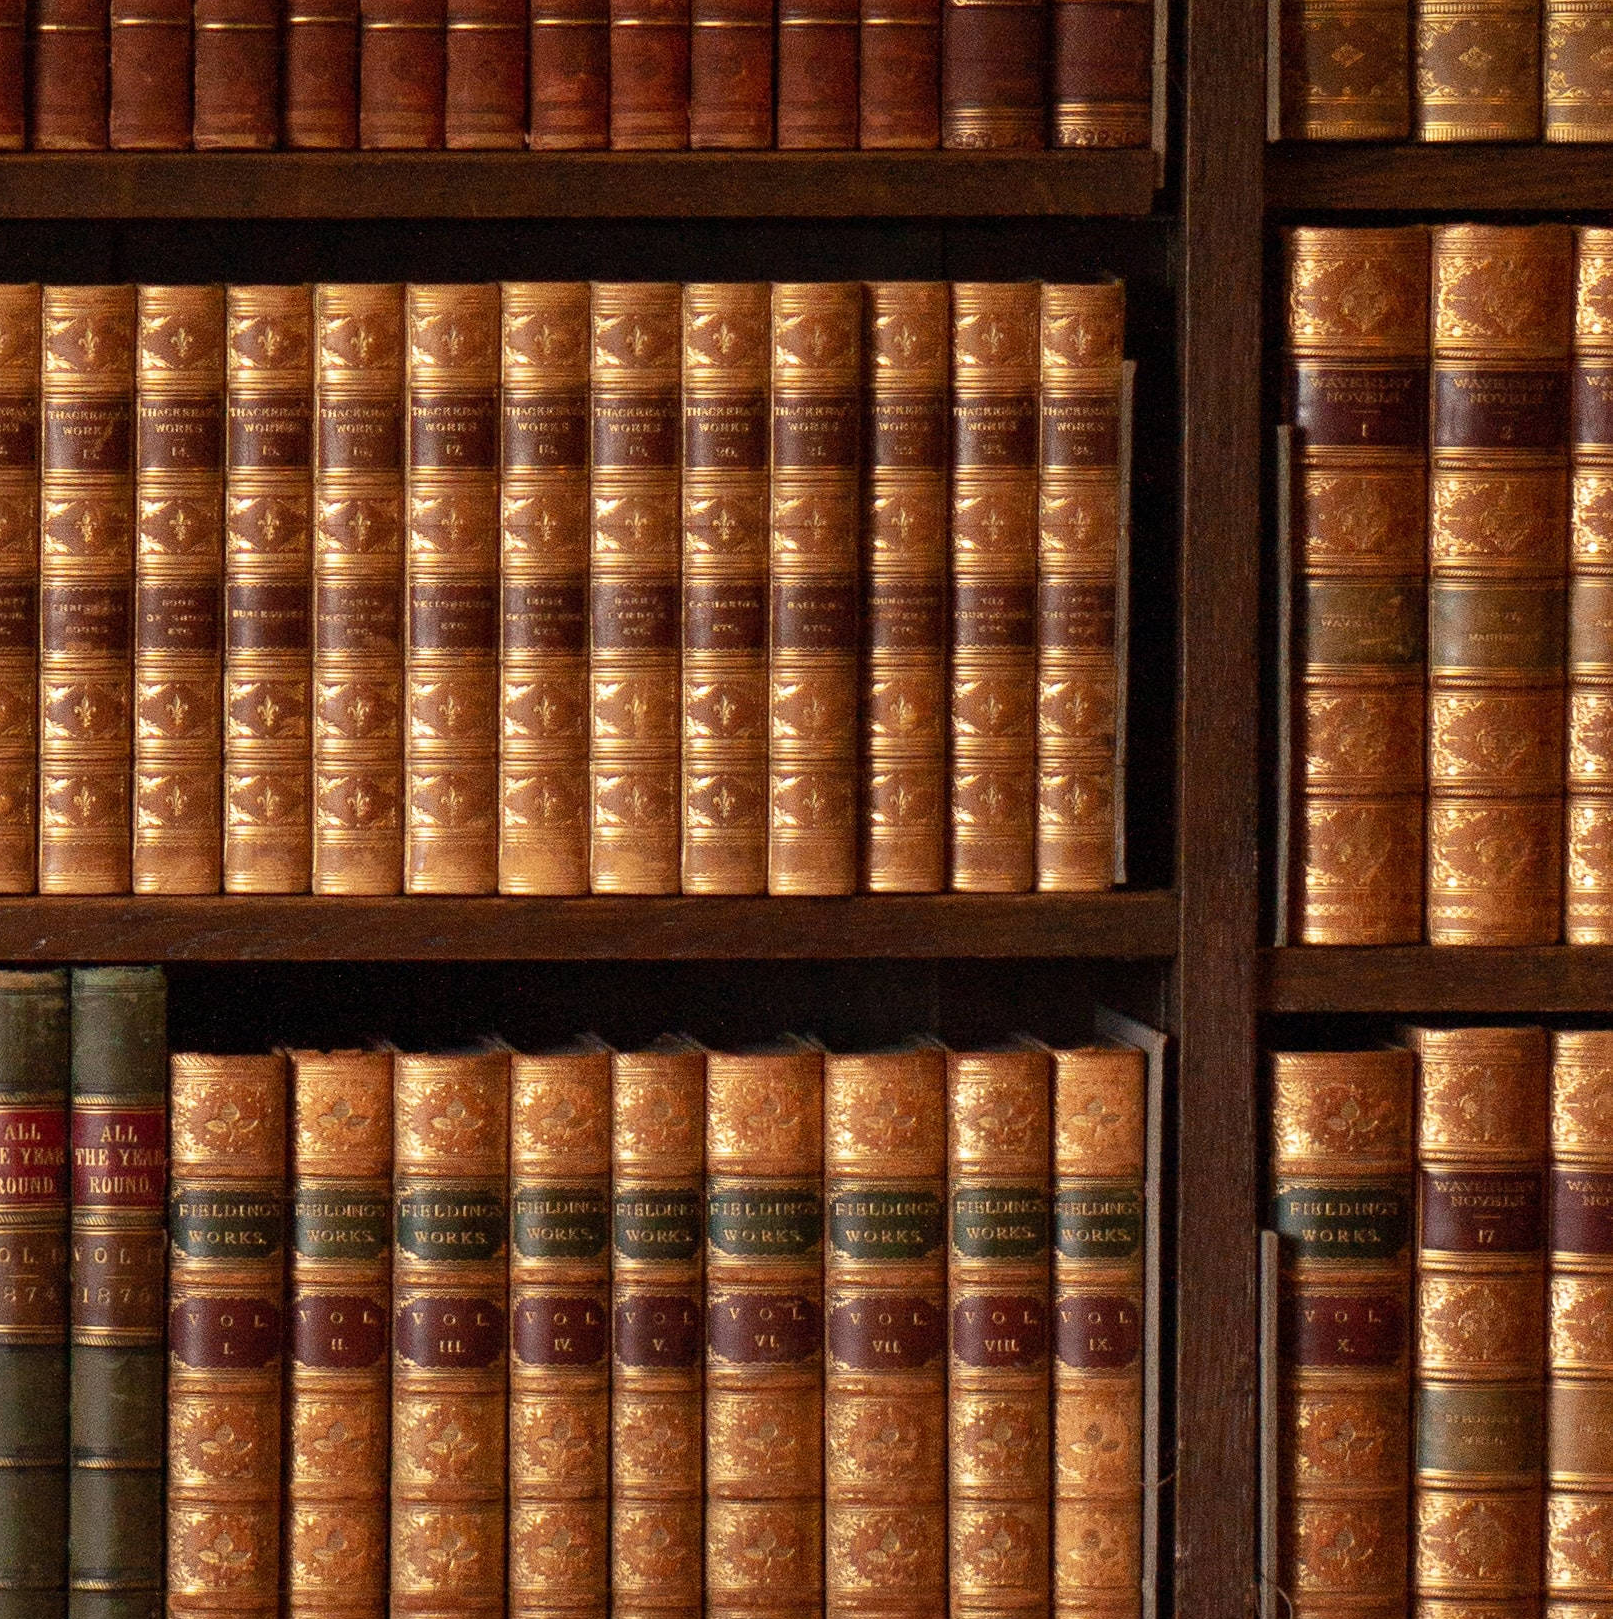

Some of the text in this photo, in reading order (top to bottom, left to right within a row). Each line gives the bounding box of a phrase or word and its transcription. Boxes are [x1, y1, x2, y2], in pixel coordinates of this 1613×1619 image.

[188, 1232, 267, 1244] WORKS.
[307, 1230, 375, 1243] WORKS.
[414, 1232, 487, 1244] WORKS.
[527, 1228, 593, 1240] WORKS.
[625, 1230, 692, 1243] WORKS.
[723, 1229, 803, 1242] WORKS.
[846, 1230, 923, 1243] WORKS.
[967, 1228, 1034, 1239] WORKS.
[1061, 1229, 1131, 1242] WORKS.
[1301, 1229, 1381, 1242] WORKS.
